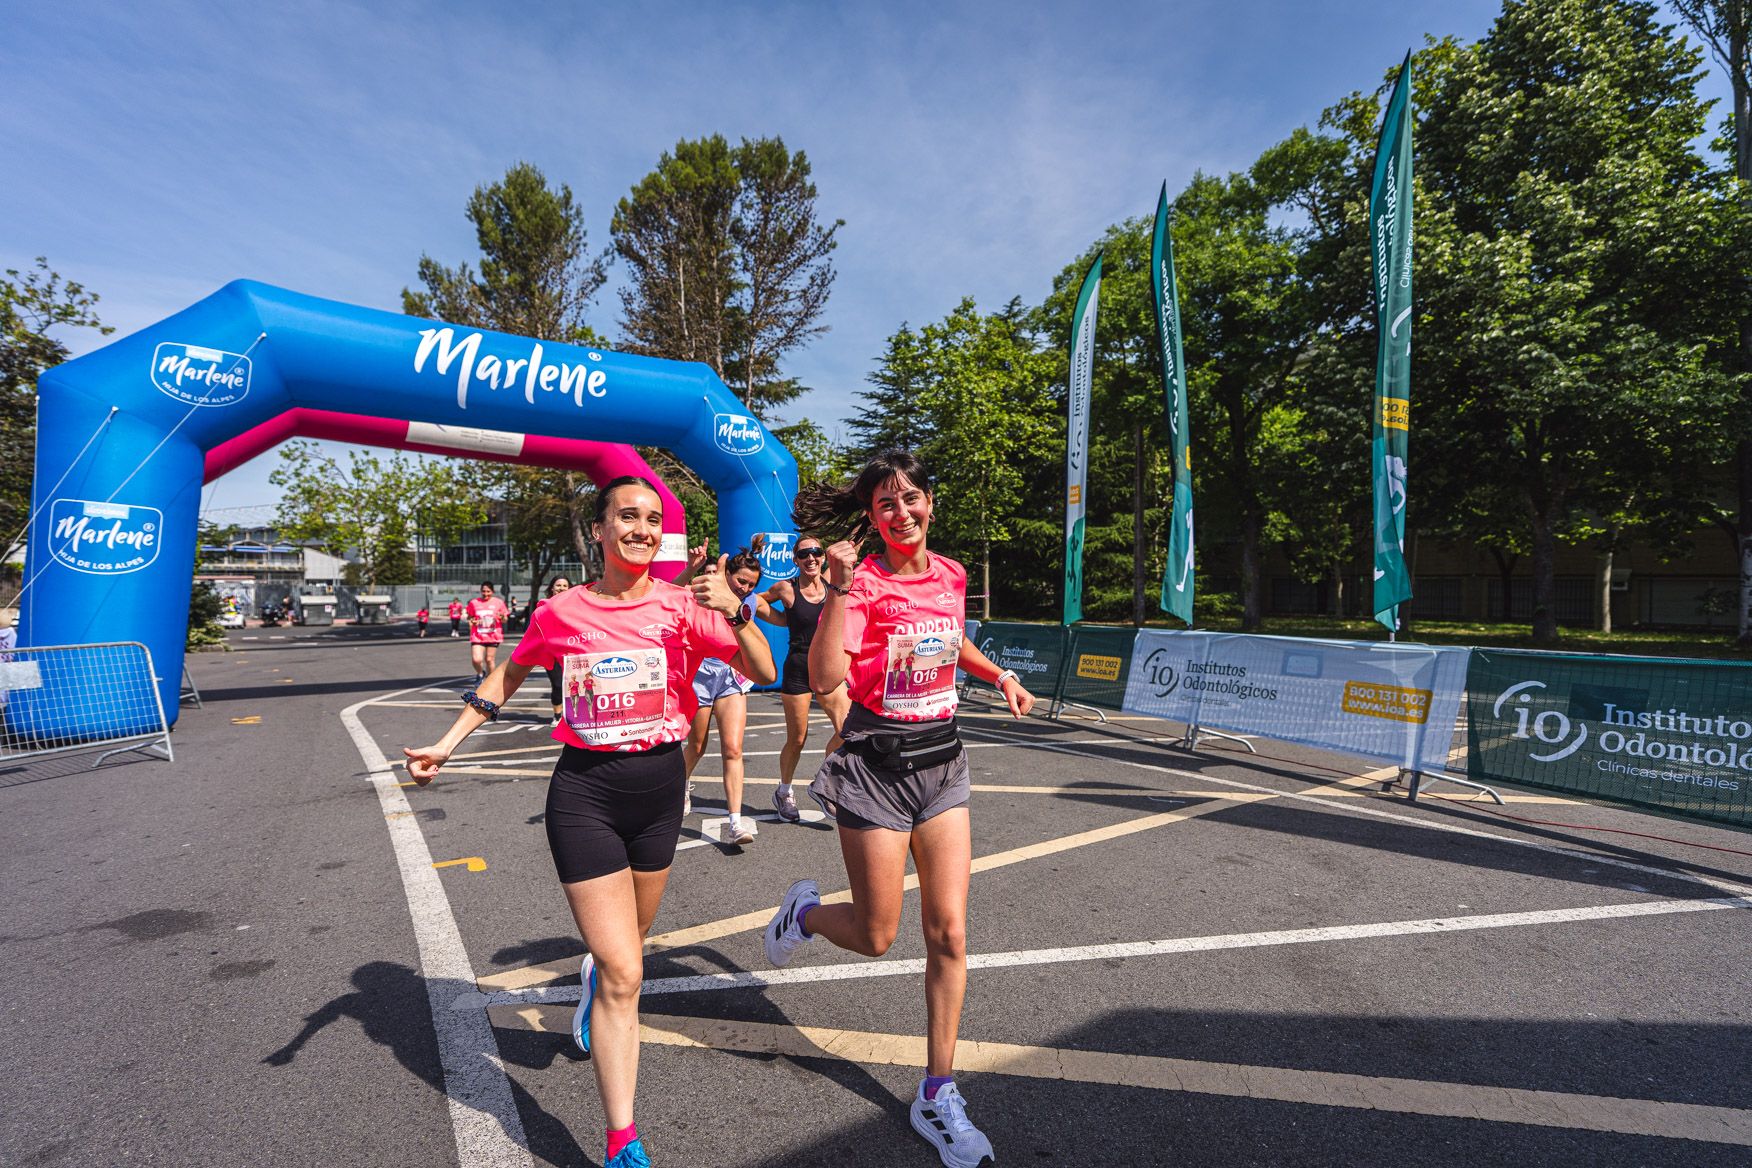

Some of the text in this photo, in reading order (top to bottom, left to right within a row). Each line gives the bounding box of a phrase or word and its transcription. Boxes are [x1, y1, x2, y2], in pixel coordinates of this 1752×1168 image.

[158, 355, 244, 389] Marlene
[413, 327, 607, 409] Marlene
[1073, 352, 1082, 417] Institutos
[180, 391, 192, 399] DE
[718, 422, 761, 444] Marlene
[54, 515, 154, 553] Marlene
[77, 559, 91, 568] DE
[92, 562, 113, 570] LOS
[115, 556, 145, 569] ALPES
[756, 543, 795, 568] Marlen
[885, 600, 918, 616] OYSHO
[567, 631, 607, 647] OYSHO
[1002, 646, 1034, 658] Institutos
[595, 665, 635, 675] ASTURIANA
[1000, 658, 1048, 673] Odontológicos
[1185, 659, 1247, 677] Institutos
[913, 668, 938, 684] 016
[1183, 676, 1278, 700] Odontológicos
[1350, 686, 1427, 706] 900 131 002
[596, 692, 636, 710] 016
[892, 701, 919, 709] OYSHO
[1348, 699, 1424, 718] www.ioa.es
[1601, 702, 1752, 739] Instituto
[1599, 730, 1752, 771] Odontoló
[1597, 759, 1740, 791] Clínicas dentales
